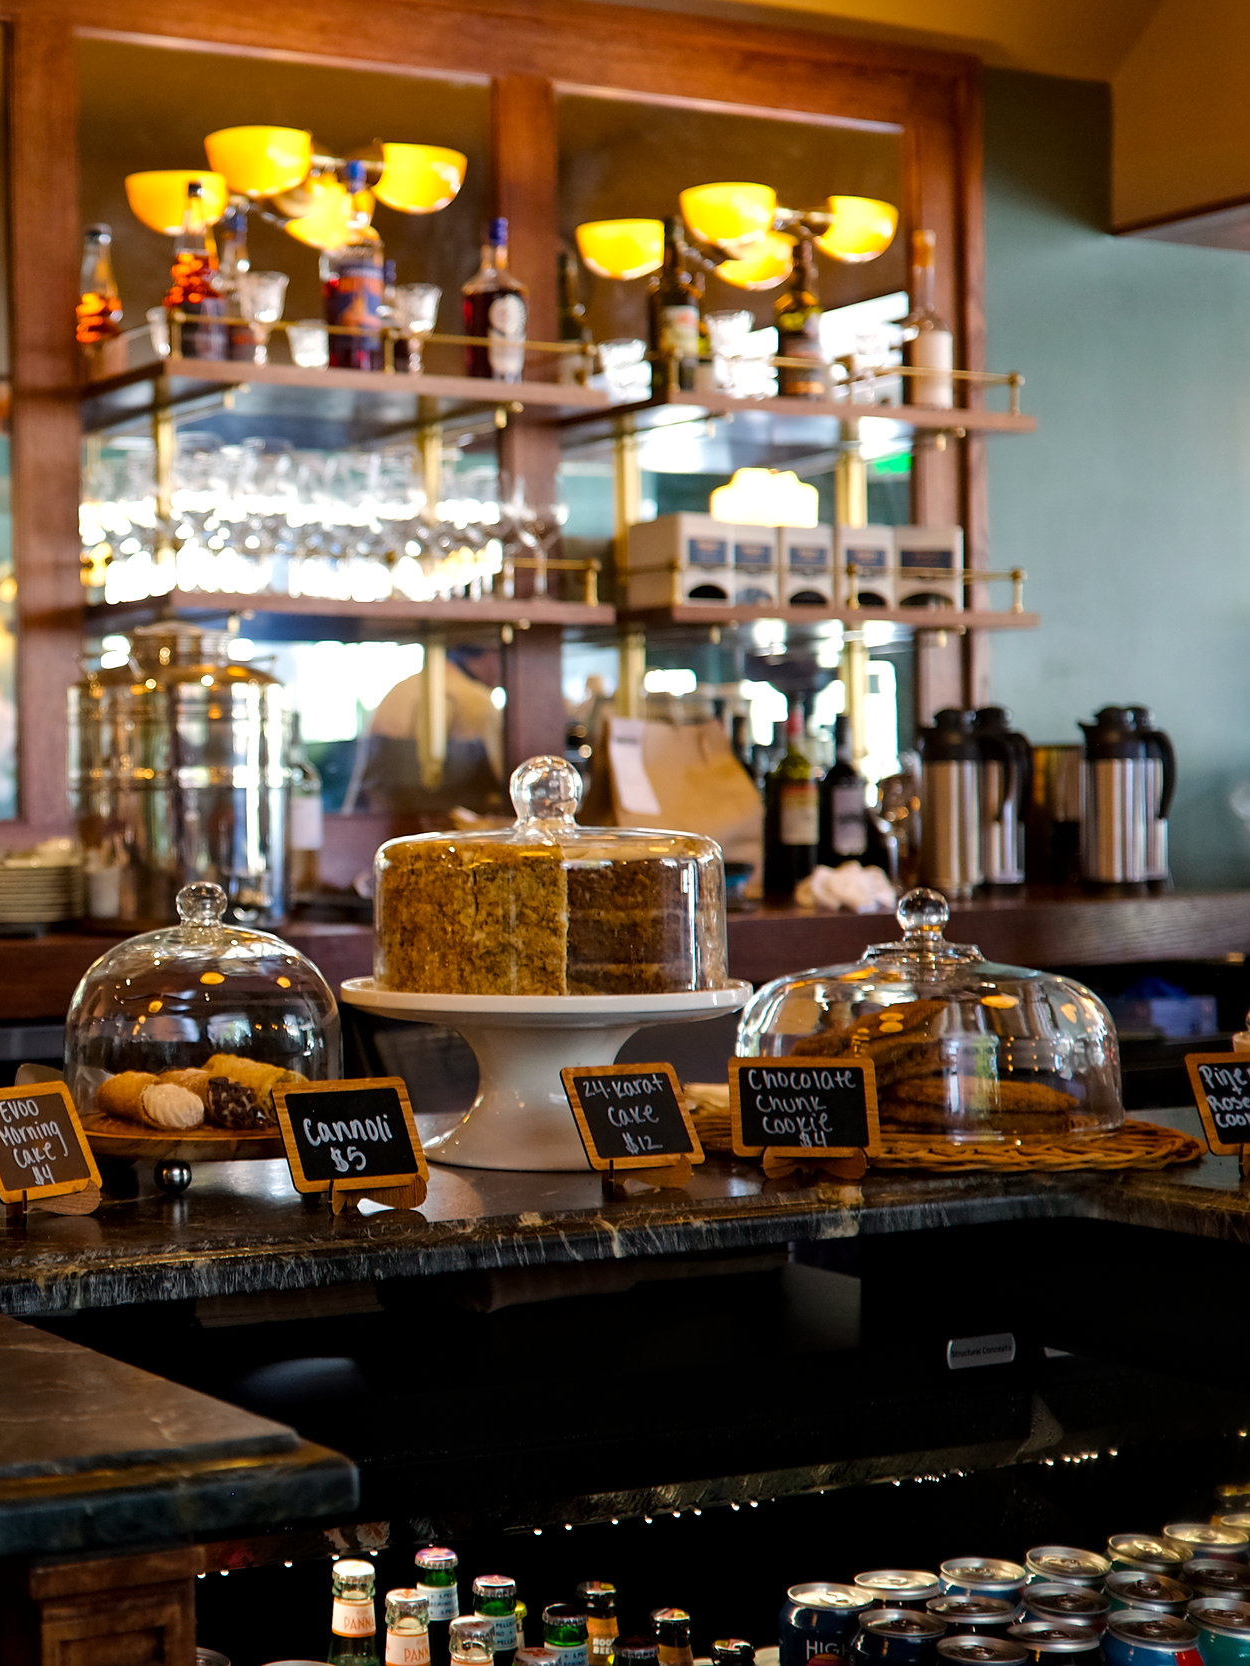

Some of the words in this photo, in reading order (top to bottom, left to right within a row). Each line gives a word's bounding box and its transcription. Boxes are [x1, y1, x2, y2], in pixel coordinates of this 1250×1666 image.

[748, 1068, 857, 1090] Chocolate
[755, 1094, 827, 1113] Chunk
[607, 1104, 660, 1127] Cake
[762, 1112, 833, 1134] Cookie
[303, 1114, 393, 1147] Cannoli
[622, 1131, 664, 1155] $12
[13, 1142, 57, 1168] Cake
[330, 1146, 367, 1172] $5
[31, 1163, 56, 1186] $4
